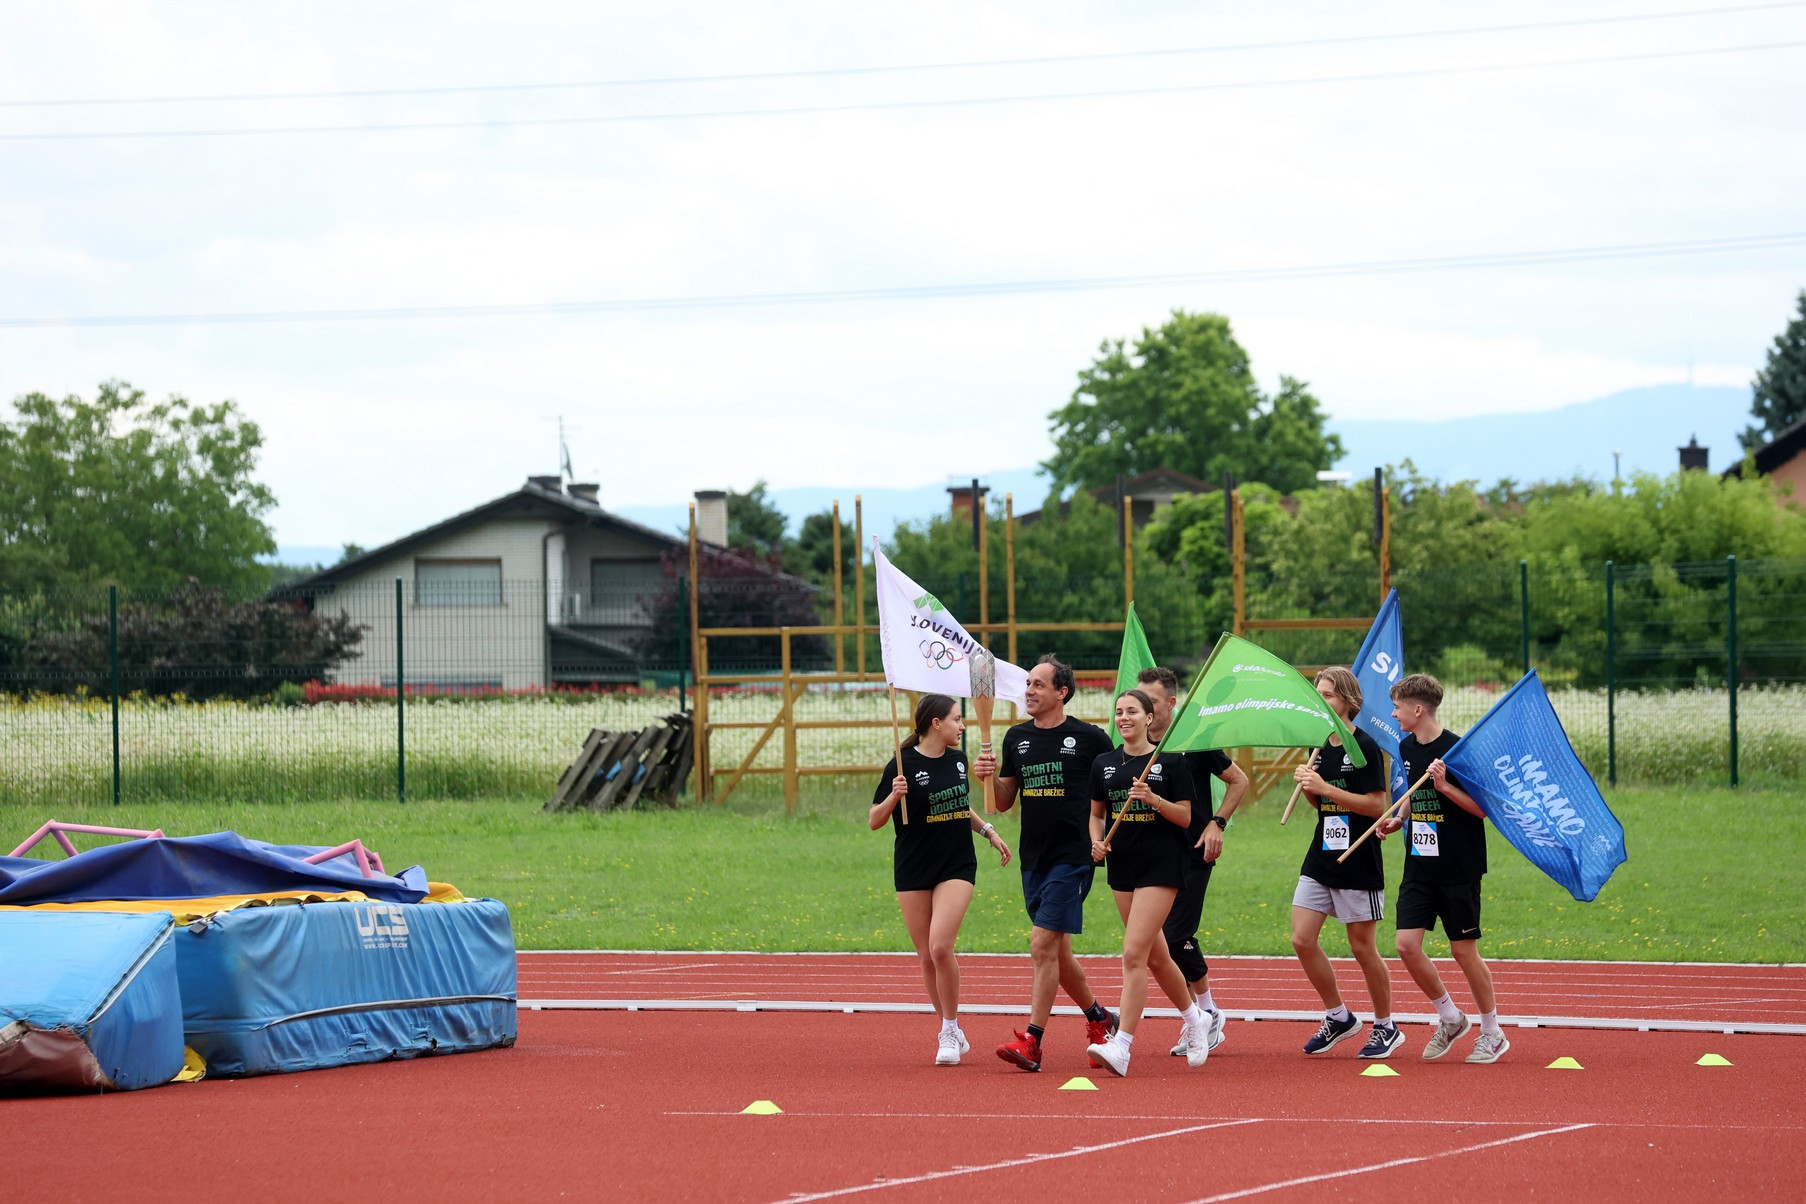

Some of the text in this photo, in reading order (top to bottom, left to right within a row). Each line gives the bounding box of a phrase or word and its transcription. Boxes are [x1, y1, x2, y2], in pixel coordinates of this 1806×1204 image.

[911, 614, 984, 655] SOVENIJ
[1198, 702, 1235, 717] Imamo
[1235, 698, 1296, 711] olimpijske
[1370, 716, 1401, 744] PREBUJA
[1021, 761, 1063, 777] ŠPORTNI
[1023, 773, 1064, 789] ODDELEK
[928, 783, 967, 805] ŠPORTNI
[1411, 788, 1438, 801] PORTNI
[1518, 754, 1586, 836] IMAMO
[929, 795, 970, 816] ODDELEK
[1325, 827, 1348, 839] 9062
[1413, 832, 1437, 846] 8278
[353, 905, 409, 937] UCS
